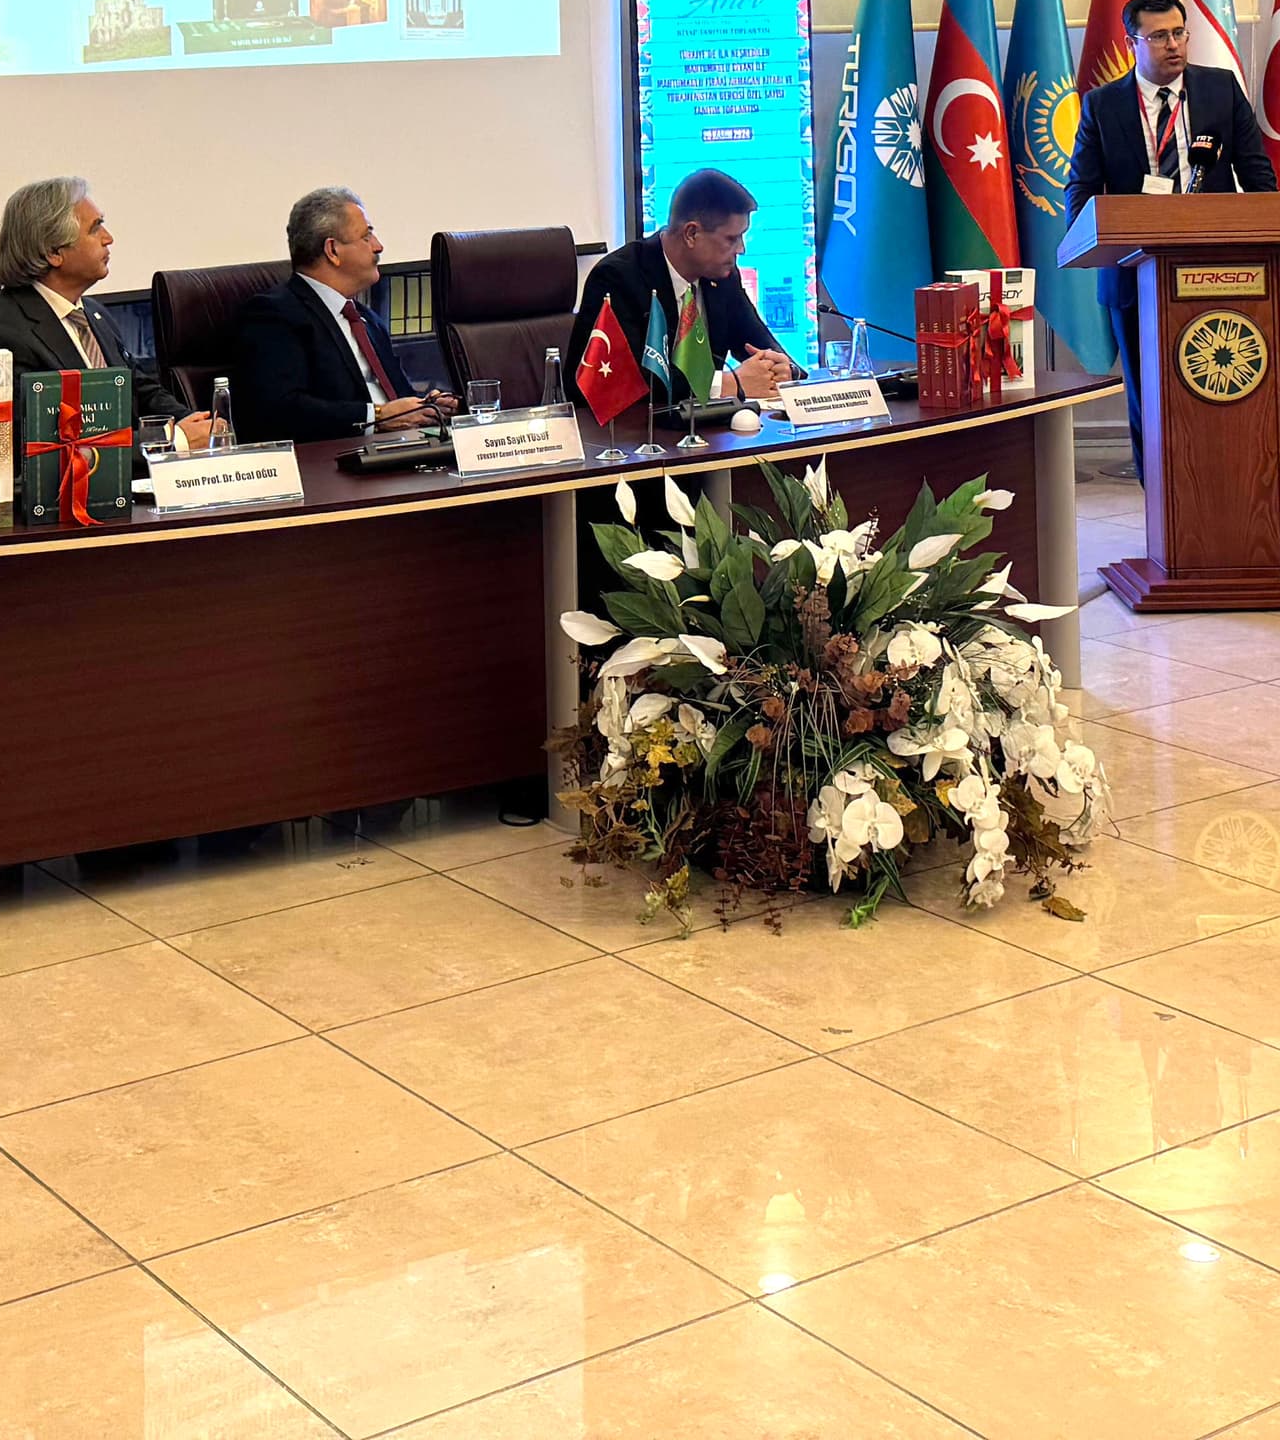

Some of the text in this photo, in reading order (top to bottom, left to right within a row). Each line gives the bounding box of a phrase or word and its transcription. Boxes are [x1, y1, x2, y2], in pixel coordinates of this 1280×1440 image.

[1181, 272, 1260, 284] TÜRKSOY
[484, 437, 507, 449] Sayın
[526, 431, 550, 443] YUSUF
[175, 468, 278, 489] Sayın Prof. Dr. Öcal OĞUZ
